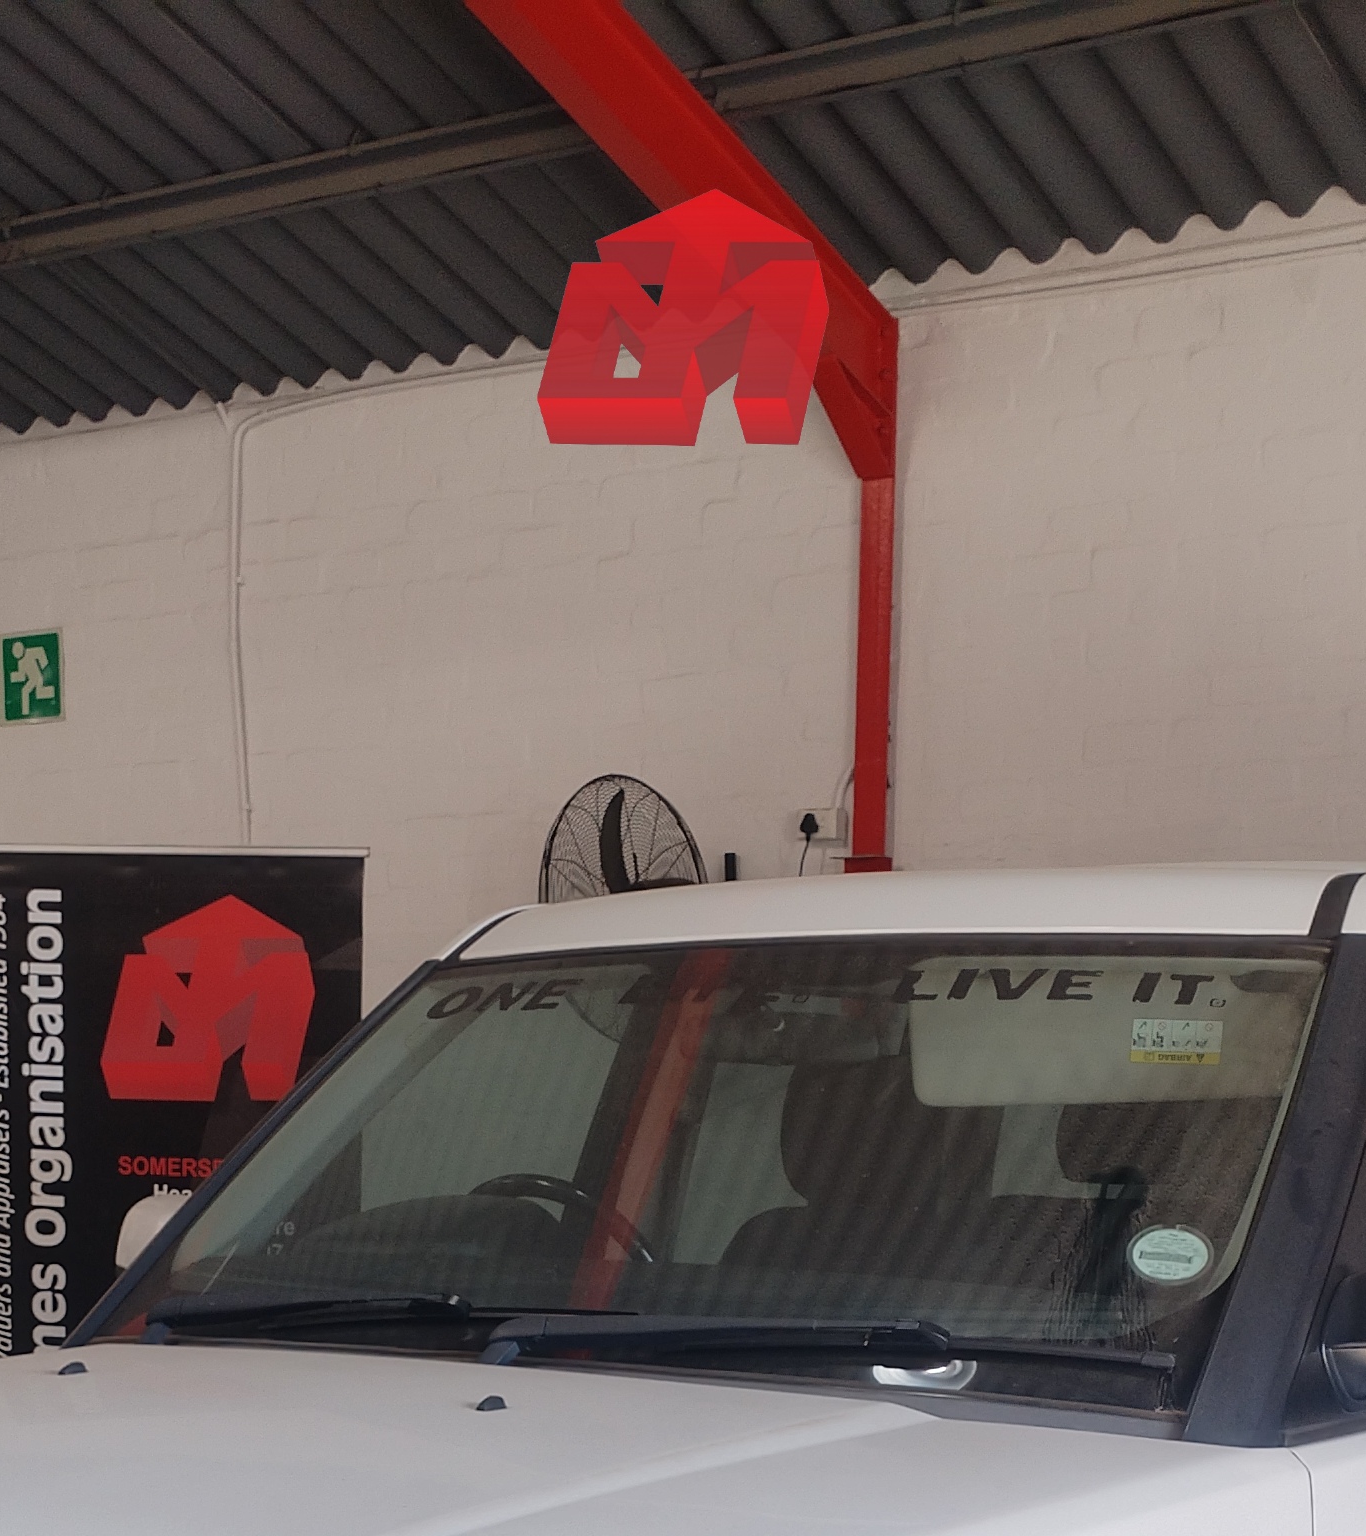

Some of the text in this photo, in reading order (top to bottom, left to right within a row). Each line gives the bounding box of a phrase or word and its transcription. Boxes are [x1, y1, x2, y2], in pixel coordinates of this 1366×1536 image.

[20, 888, 73, 1247] Organisation
[427, 977, 584, 1020] ONE
[896, 967, 1101, 1004] LIVE
